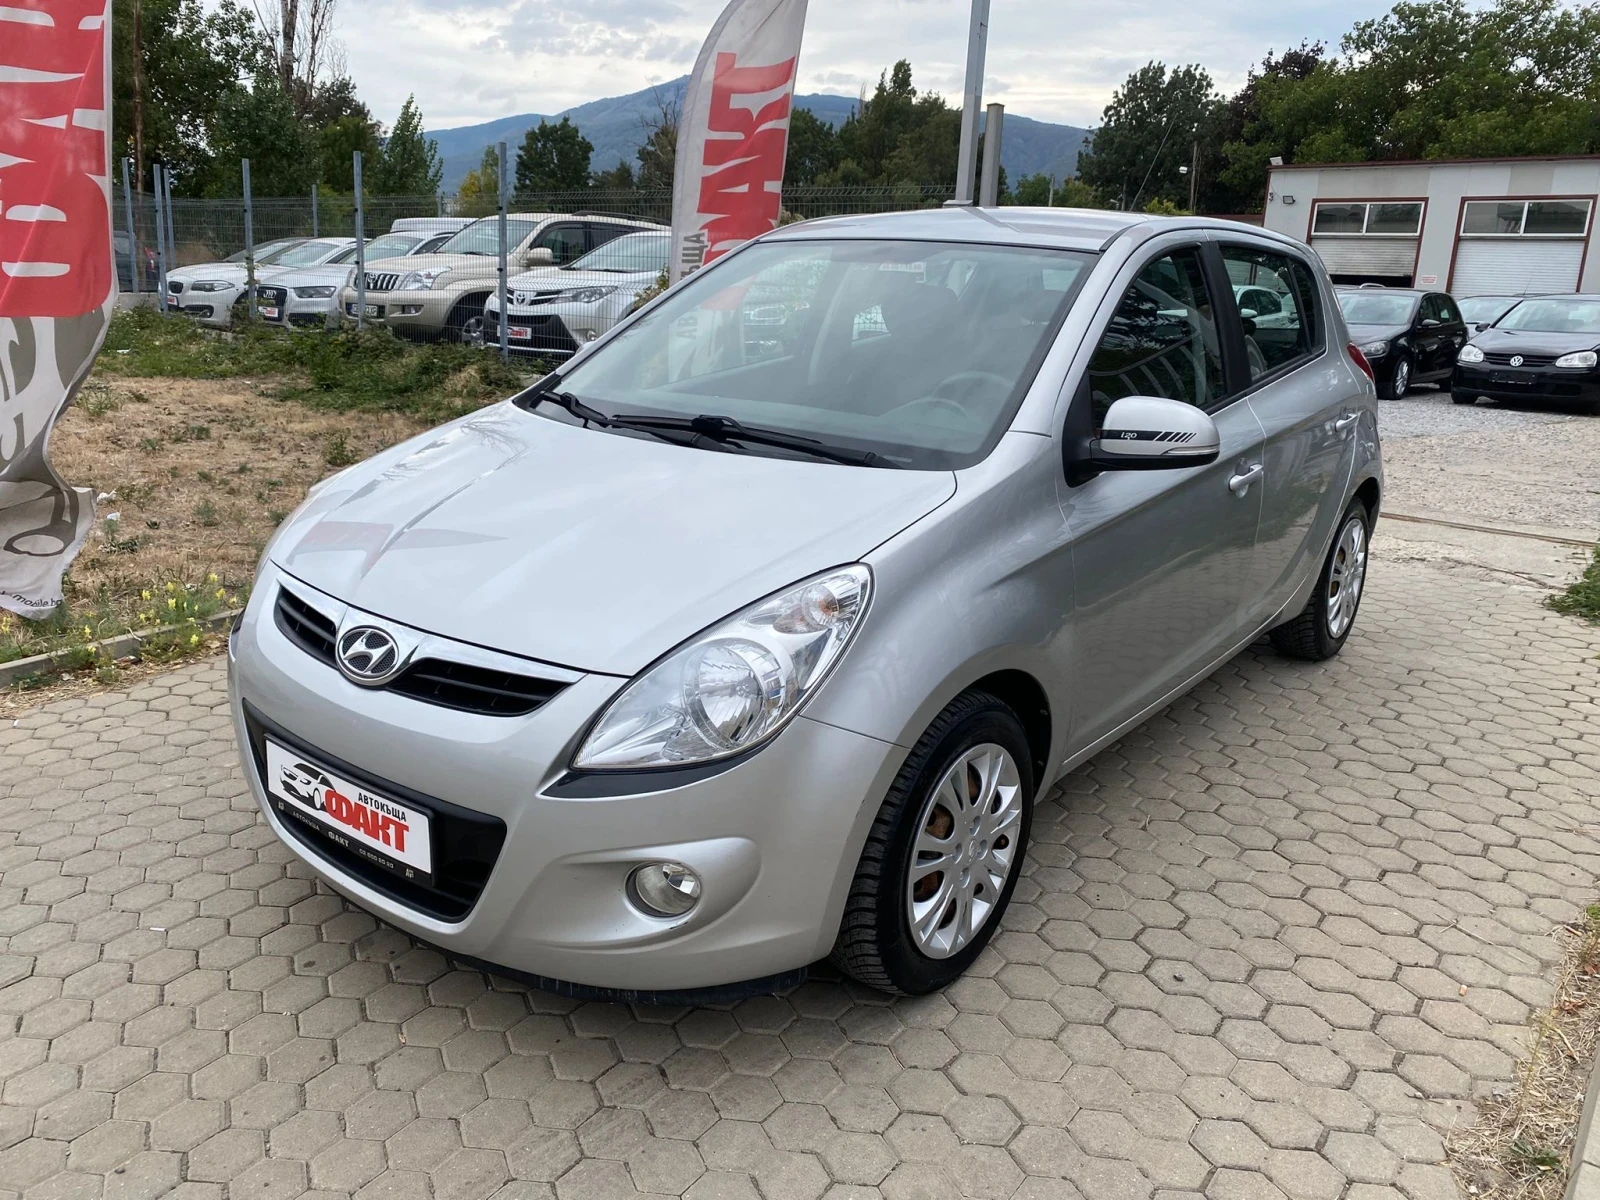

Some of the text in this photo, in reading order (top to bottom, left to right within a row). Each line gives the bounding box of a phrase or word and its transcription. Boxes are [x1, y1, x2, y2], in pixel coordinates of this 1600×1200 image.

[325, 788, 410, 853] ФАКТ
[358, 791, 407, 822] АВТОКЪЩА
[328, 831, 349, 848] ФАКТ
